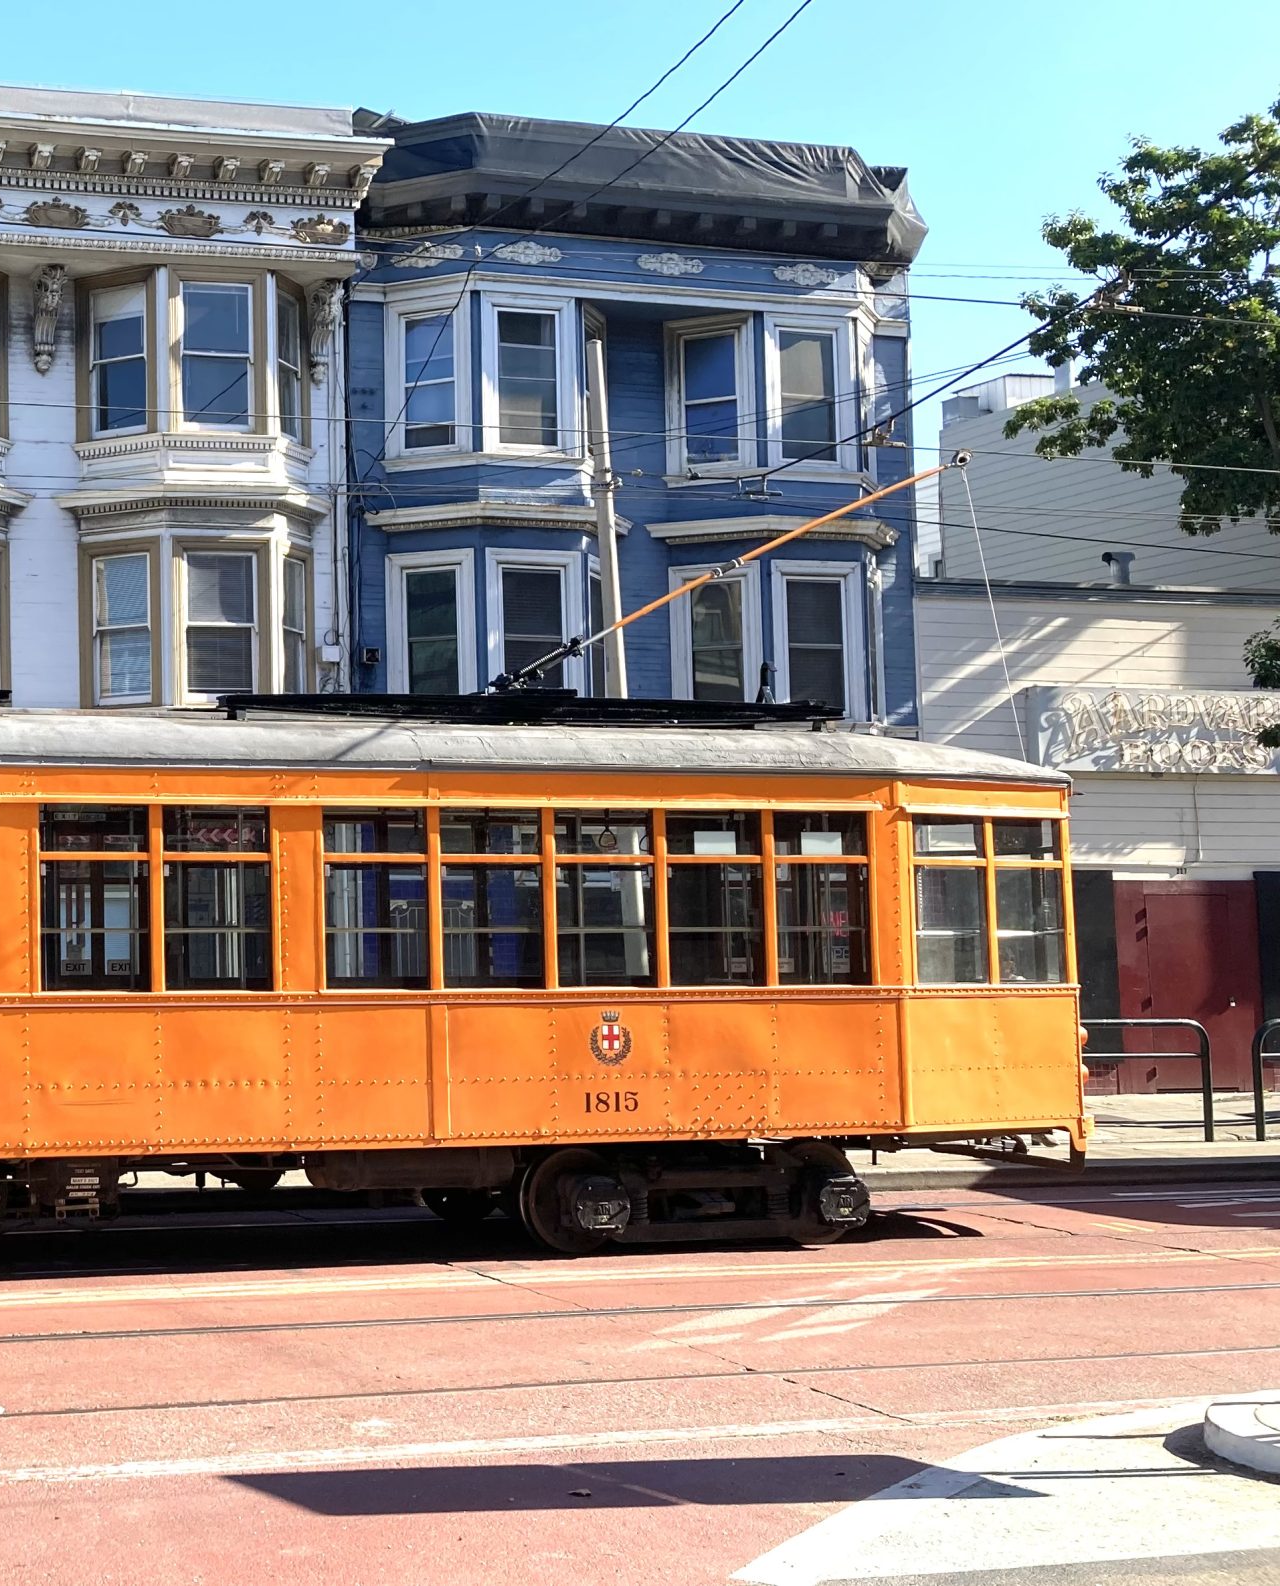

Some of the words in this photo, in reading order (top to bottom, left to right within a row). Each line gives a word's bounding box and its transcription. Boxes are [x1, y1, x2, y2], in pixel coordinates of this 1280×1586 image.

[1061, 690, 1280, 759] AARDVAR
[1120, 738, 1271, 770] BOOKS
[65, 962, 87, 973] EXIT
[585, 1091, 639, 1113] 1815
